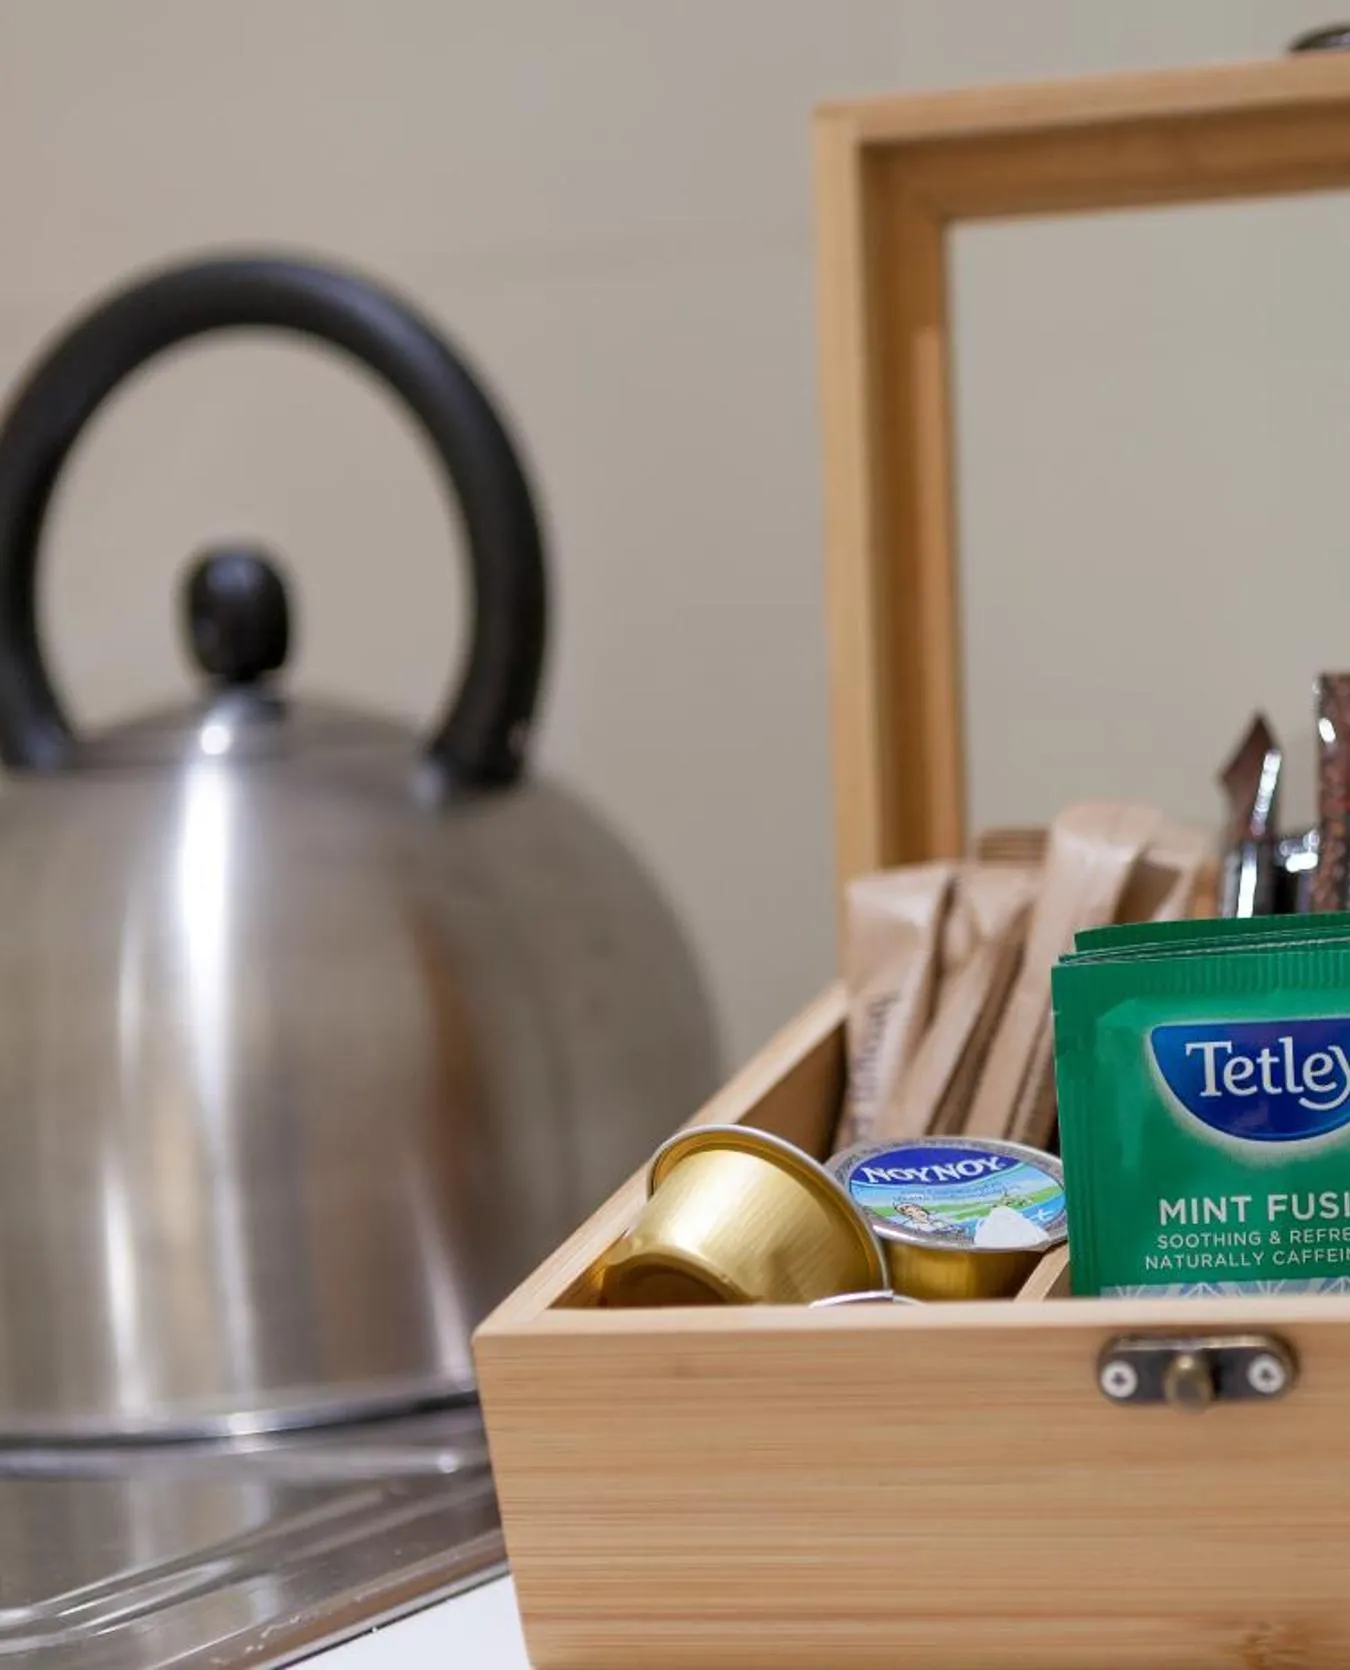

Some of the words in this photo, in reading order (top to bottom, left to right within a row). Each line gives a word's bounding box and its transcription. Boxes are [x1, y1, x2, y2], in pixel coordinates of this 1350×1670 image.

[861, 1156, 1001, 1184] NOYNOY
[1159, 1195, 1252, 1226] MINT
[1157, 1230, 1262, 1250] SOOTHING
[1269, 1230, 1281, 1245] &
[1145, 1251, 1265, 1271] NATURALLY
